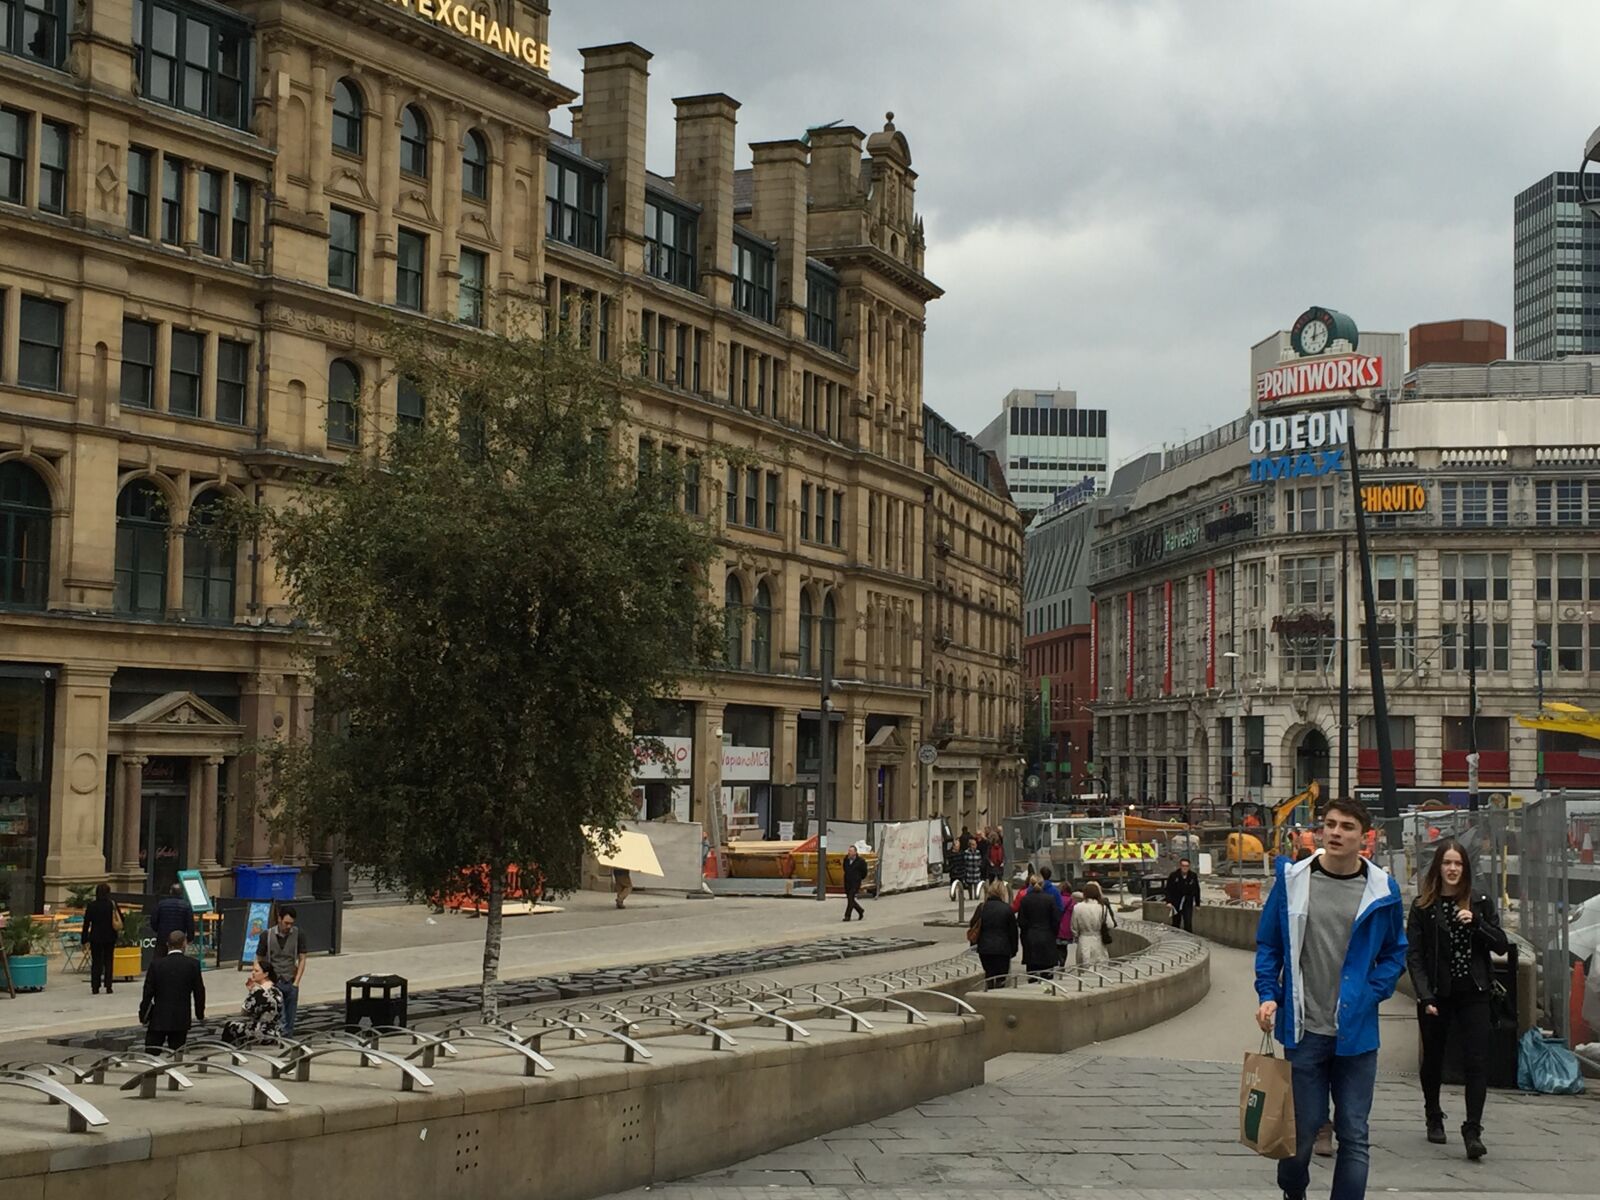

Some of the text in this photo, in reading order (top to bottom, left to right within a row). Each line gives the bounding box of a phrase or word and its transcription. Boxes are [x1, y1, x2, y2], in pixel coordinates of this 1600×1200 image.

[1263, 357, 1379, 399] PRINTWORKS
[1250, 408, 1349, 454] ODEON
[1250, 449, 1345, 482] IMAX
[1164, 527, 1201, 551] Harvester
